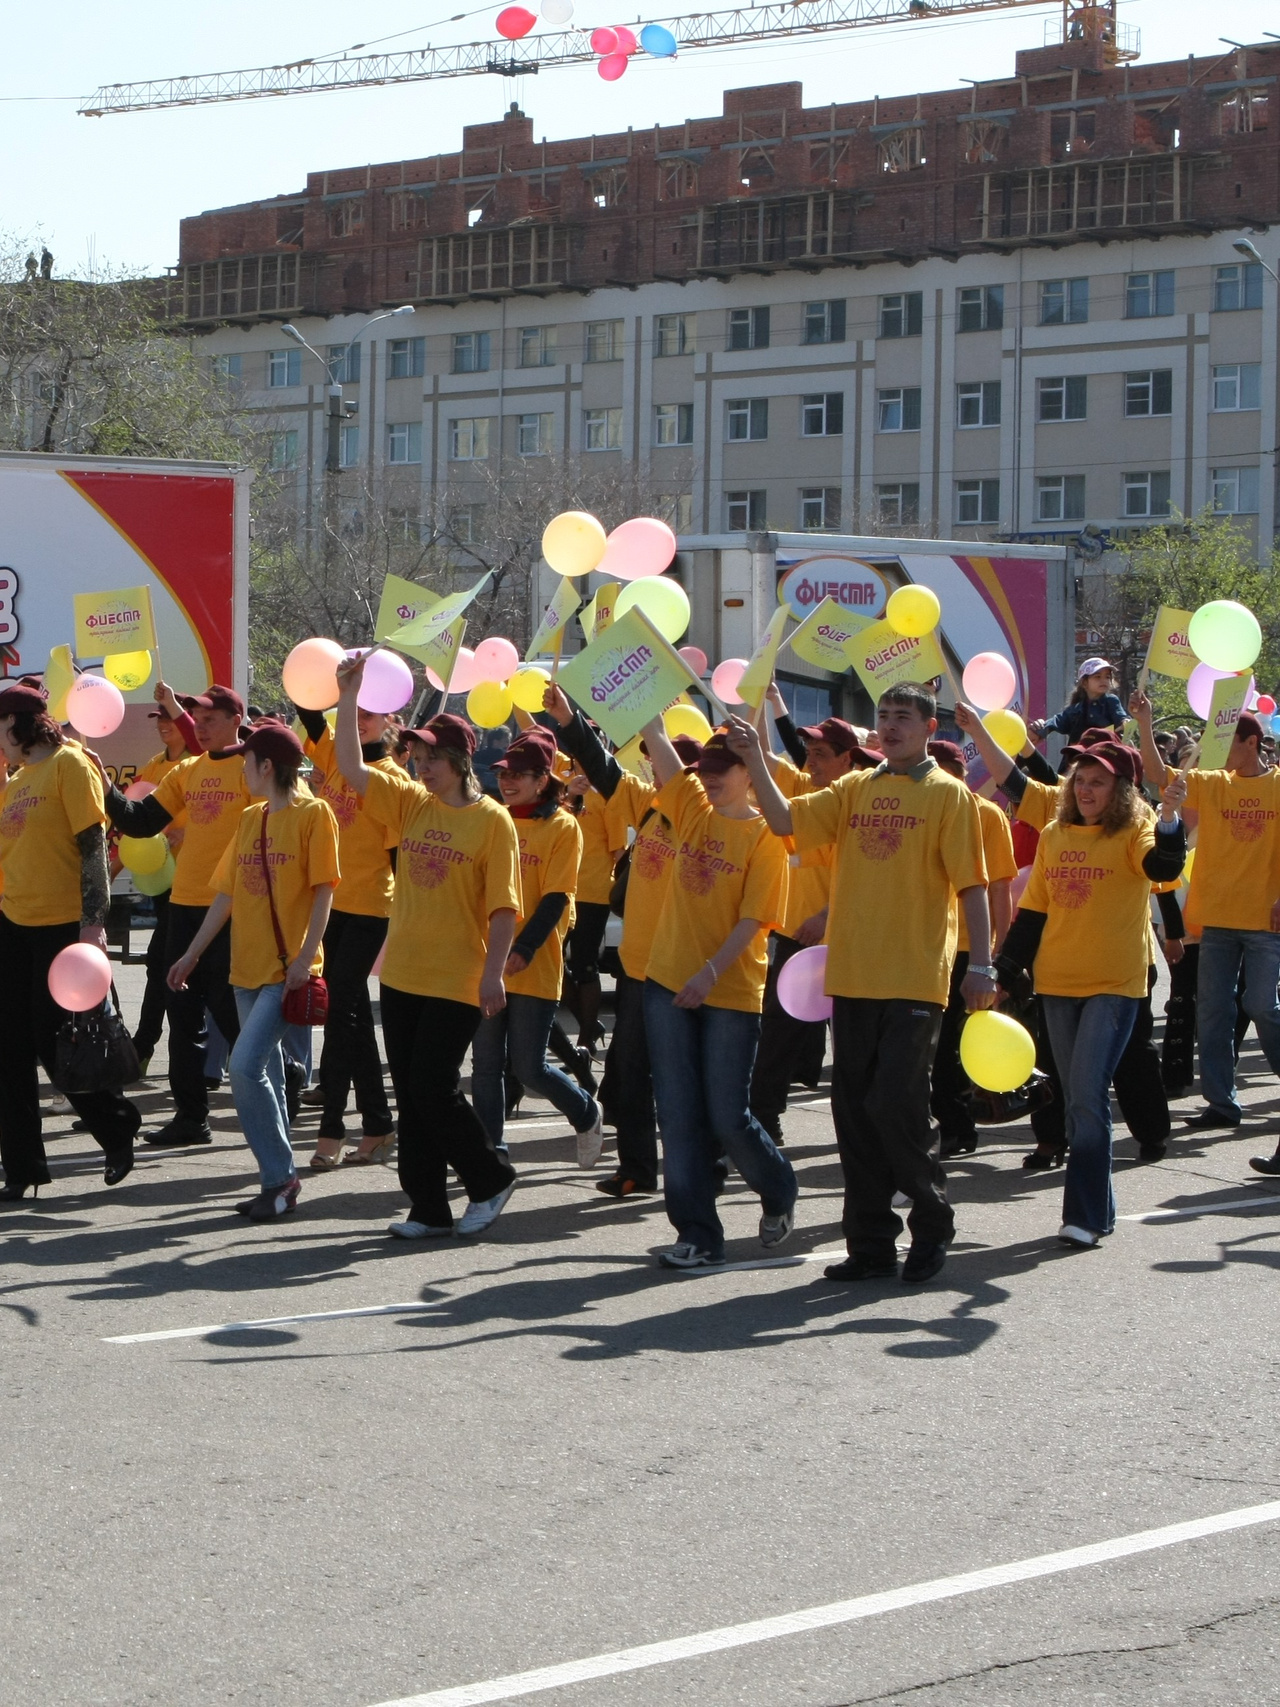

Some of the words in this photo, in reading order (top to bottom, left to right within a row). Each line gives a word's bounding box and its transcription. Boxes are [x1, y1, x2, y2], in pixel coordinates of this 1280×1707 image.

[85, 609, 141, 629] ФИЕСТА
[590, 644, 653, 702] ФИЕСТА
[200, 777, 222, 788] ООО
[871, 796, 900, 810] ООО
[1238, 798, 1260, 808] ООО
[424, 829, 452, 843] ООО
[253, 837, 273, 850] ОО
[1060, 850, 1087, 863] ООО
